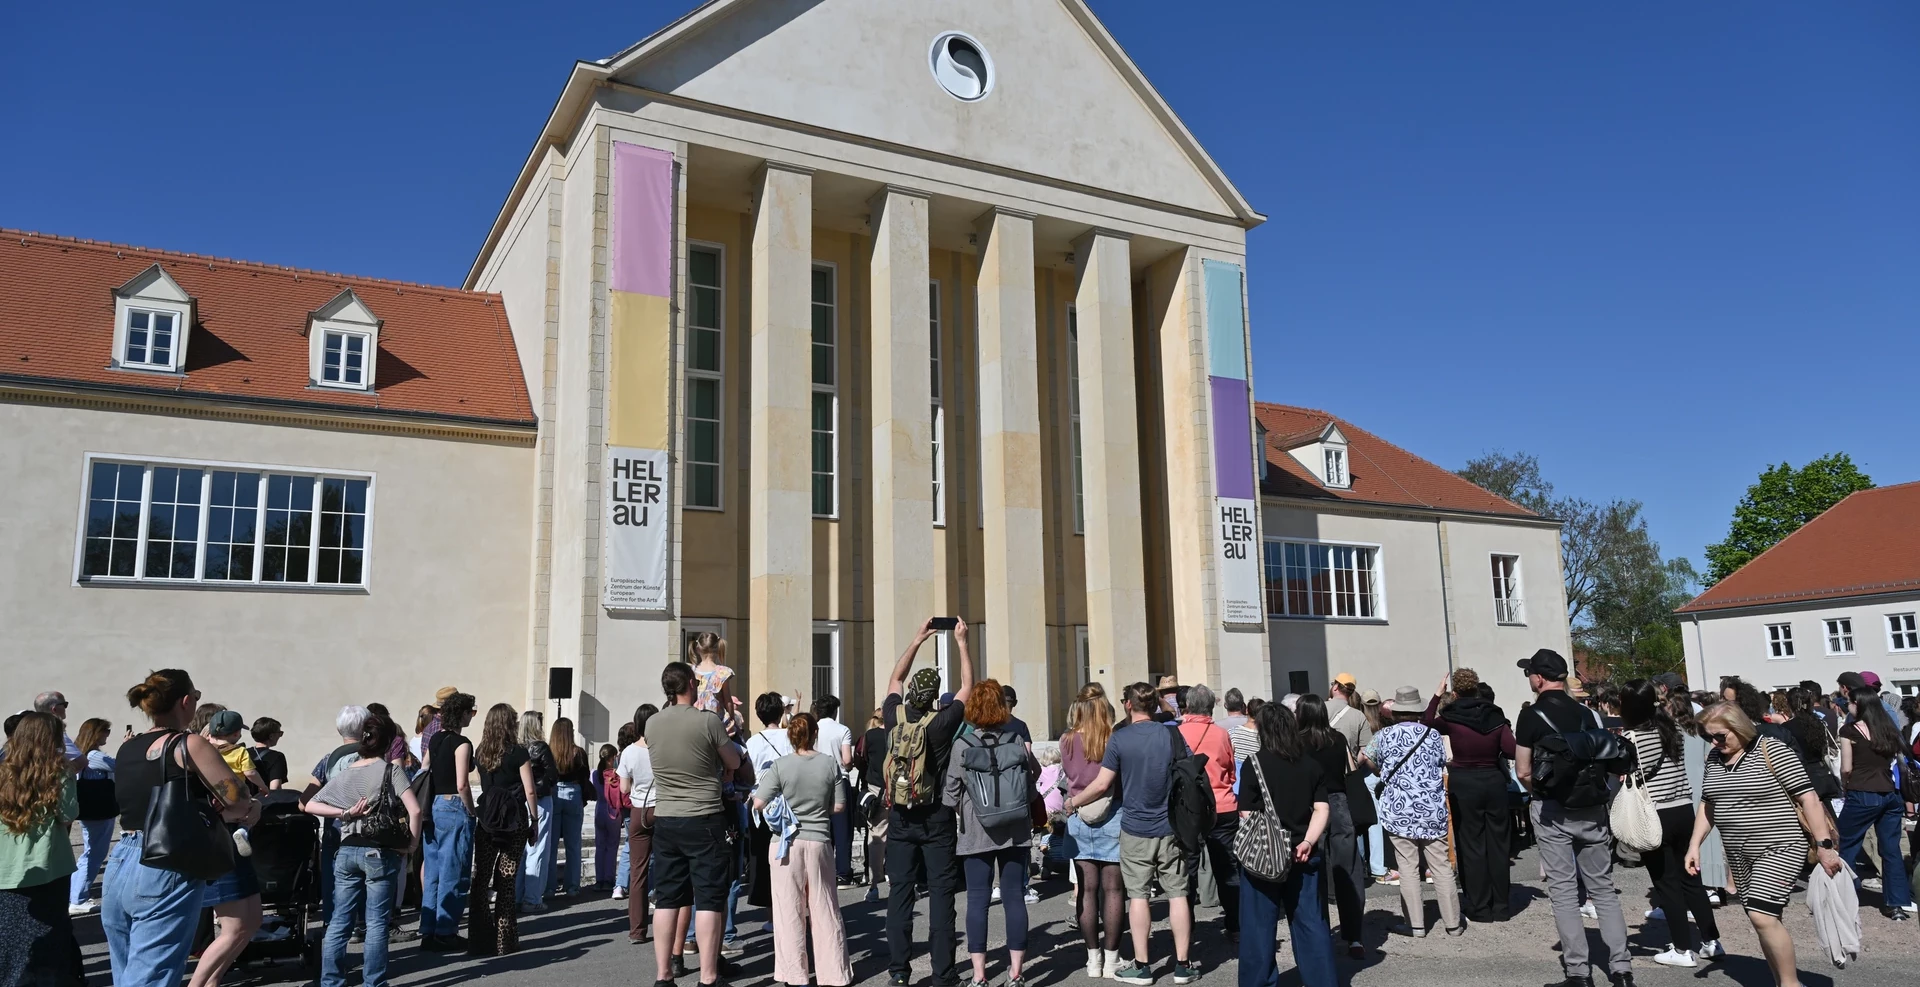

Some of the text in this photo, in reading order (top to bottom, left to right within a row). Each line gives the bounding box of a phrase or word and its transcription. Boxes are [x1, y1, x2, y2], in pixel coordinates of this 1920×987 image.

[613, 457, 662, 481] HEL
[612, 481, 661, 504] LER
[612, 504, 648, 527] au
[1221, 506, 1252, 524] HEL
[1222, 524, 1252, 541] LER
[1223, 542, 1246, 559] au
